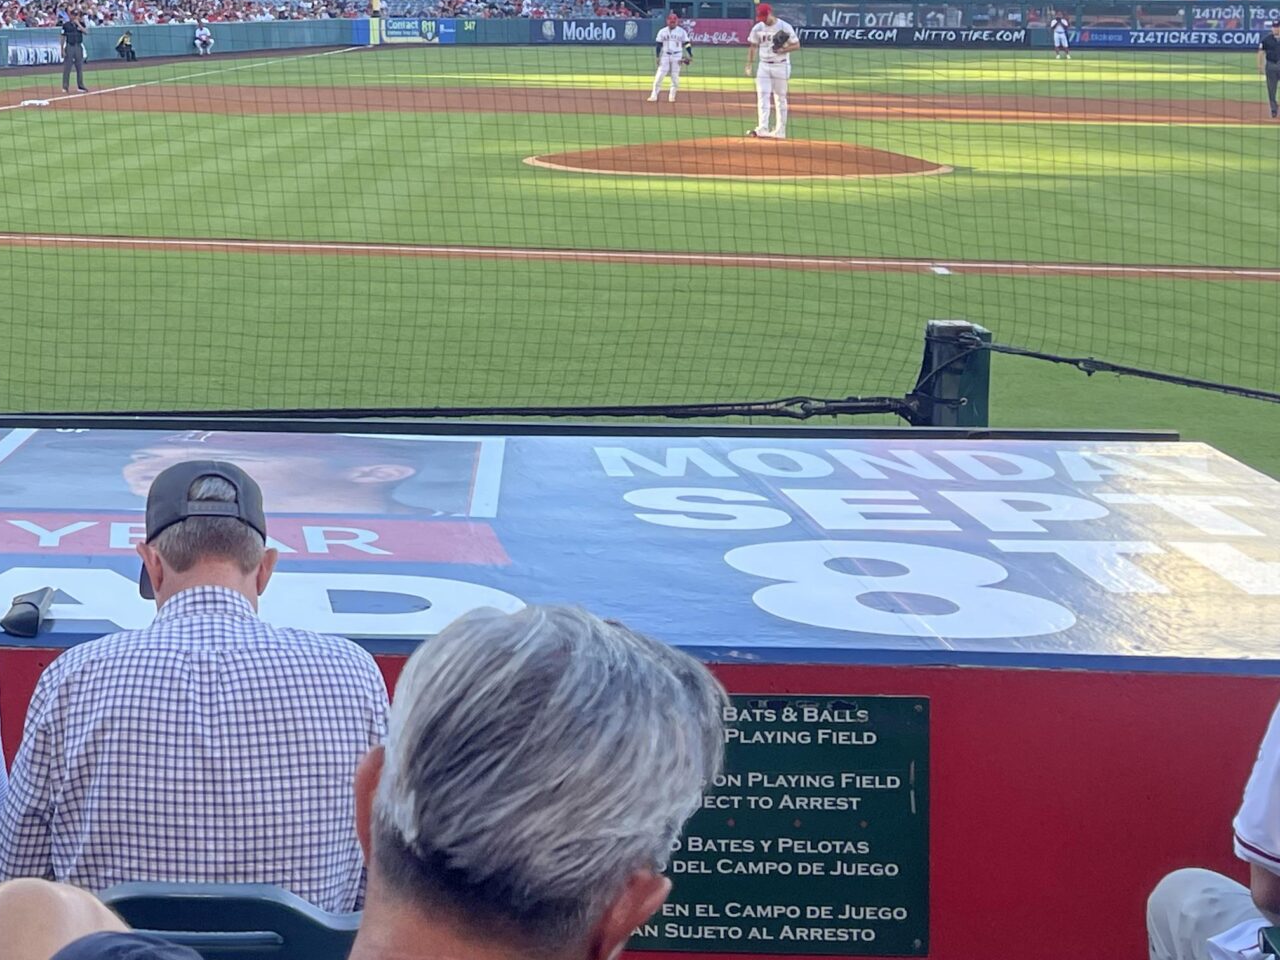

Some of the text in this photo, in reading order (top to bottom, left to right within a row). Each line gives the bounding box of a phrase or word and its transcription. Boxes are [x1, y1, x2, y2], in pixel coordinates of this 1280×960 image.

[387, 20, 418, 29] Contact
[422, 21, 436, 33] 811
[464, 21, 476, 30] 347
[563, 22, 616, 41] Modelo
[834, 28, 898, 41] TIRE.COM
[914, 29, 1025, 42] NITTO TIRE.COM
[1129, 32, 1260, 44] 714TICKETS.COM
[623, 487, 1267, 537] SEPT
[7, 519, 393, 555] YER
[723, 707, 869, 722] BATS & BALLS
[724, 729, 877, 745] PLAYING FIELD
[713, 775, 741, 787] ON
[748, 772, 835, 788] PLAYING
[841, 773, 901, 789] FIELD
[701, 794, 861, 810] ECT TO ARREST
[687, 837, 754, 853] BATES
[760, 840, 772, 852] Y
[778, 838, 870, 854] PELOTAS
[673, 861, 712, 874] DEL
[717, 859, 792, 875] CAMPO
[798, 862, 825, 875] DE
[830, 860, 899, 877] JUEGO
[662, 902, 908, 920] EN EL CAMPO DE JUEGO
[665, 923, 876, 941] SUJETO AL ARRESTO
